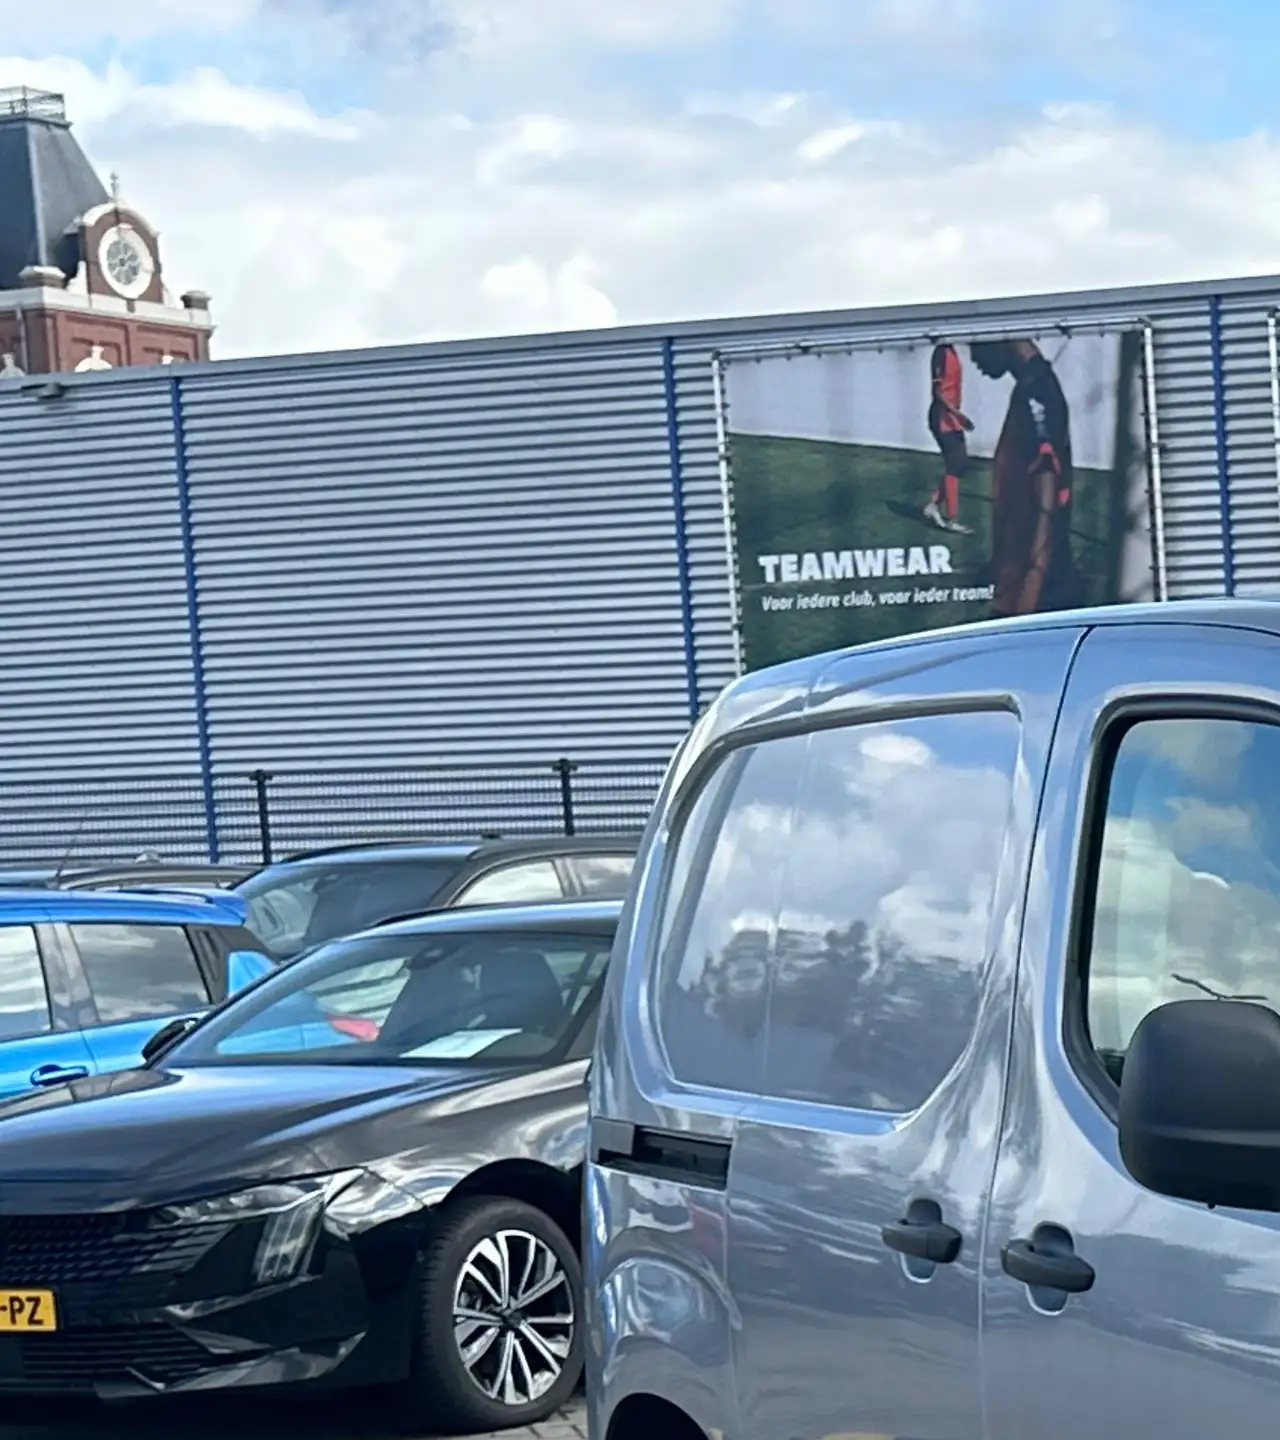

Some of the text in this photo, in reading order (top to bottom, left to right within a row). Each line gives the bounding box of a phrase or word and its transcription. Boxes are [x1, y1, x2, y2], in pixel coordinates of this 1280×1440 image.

[758, 545, 952, 583] TEAMWEAR
[762, 596, 794, 611] Voor
[796, 594, 840, 610] iedere
[843, 589, 877, 608] club,
[880, 592, 910, 605] voor
[953, 585, 994, 601] team!
